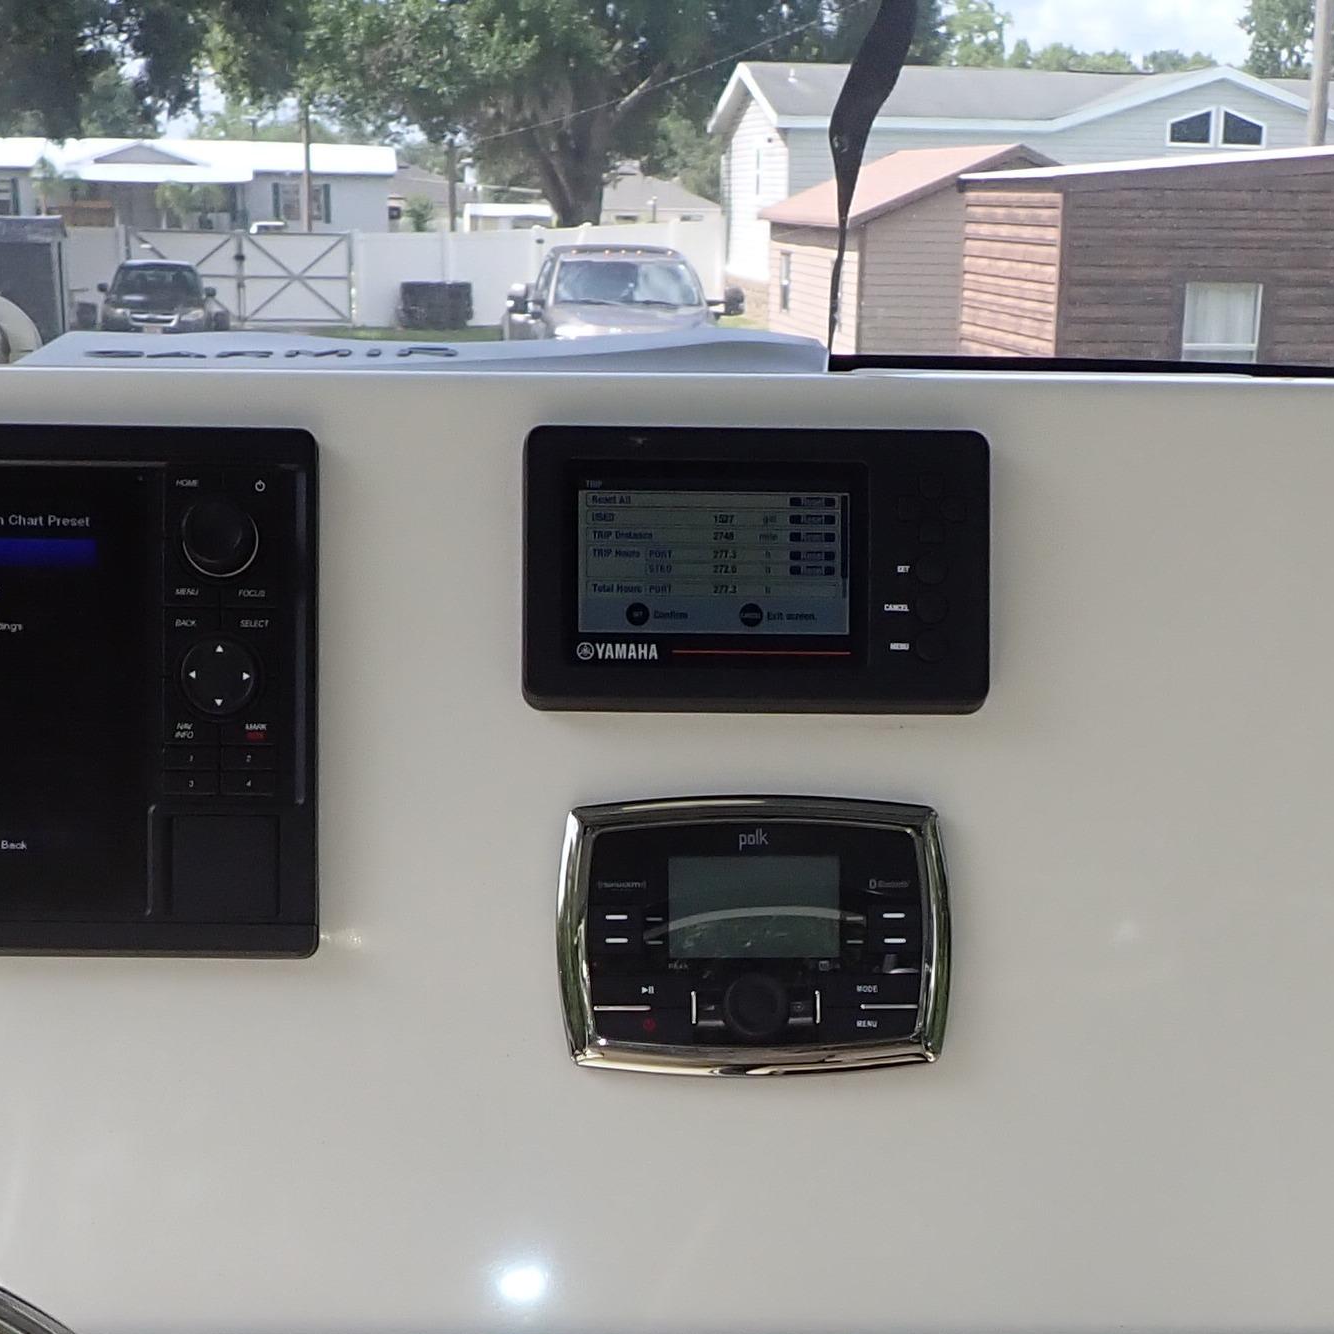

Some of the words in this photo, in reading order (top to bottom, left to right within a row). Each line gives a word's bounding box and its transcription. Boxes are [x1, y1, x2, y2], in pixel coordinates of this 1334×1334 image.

[175, 479, 199, 487] HOME
[8, 514, 43, 527] Chart
[47, 515, 91, 527] Preset
[175, 588, 199, 596] MENU
[592, 584, 614, 593] Total
[238, 589, 266, 597] FOCUS
[884, 604, 909, 612] CANCEL
[767, 611, 784, 621] Exit
[175, 619, 197, 628] BACK
[240, 620, 269, 628] SELECT
[595, 643, 659, 660] YAMAHA
[738, 828, 769, 850] polk
[0, 840, 28, 850] Back
[856, 985, 878, 993] MODE
[856, 1020, 878, 1028] MENU
